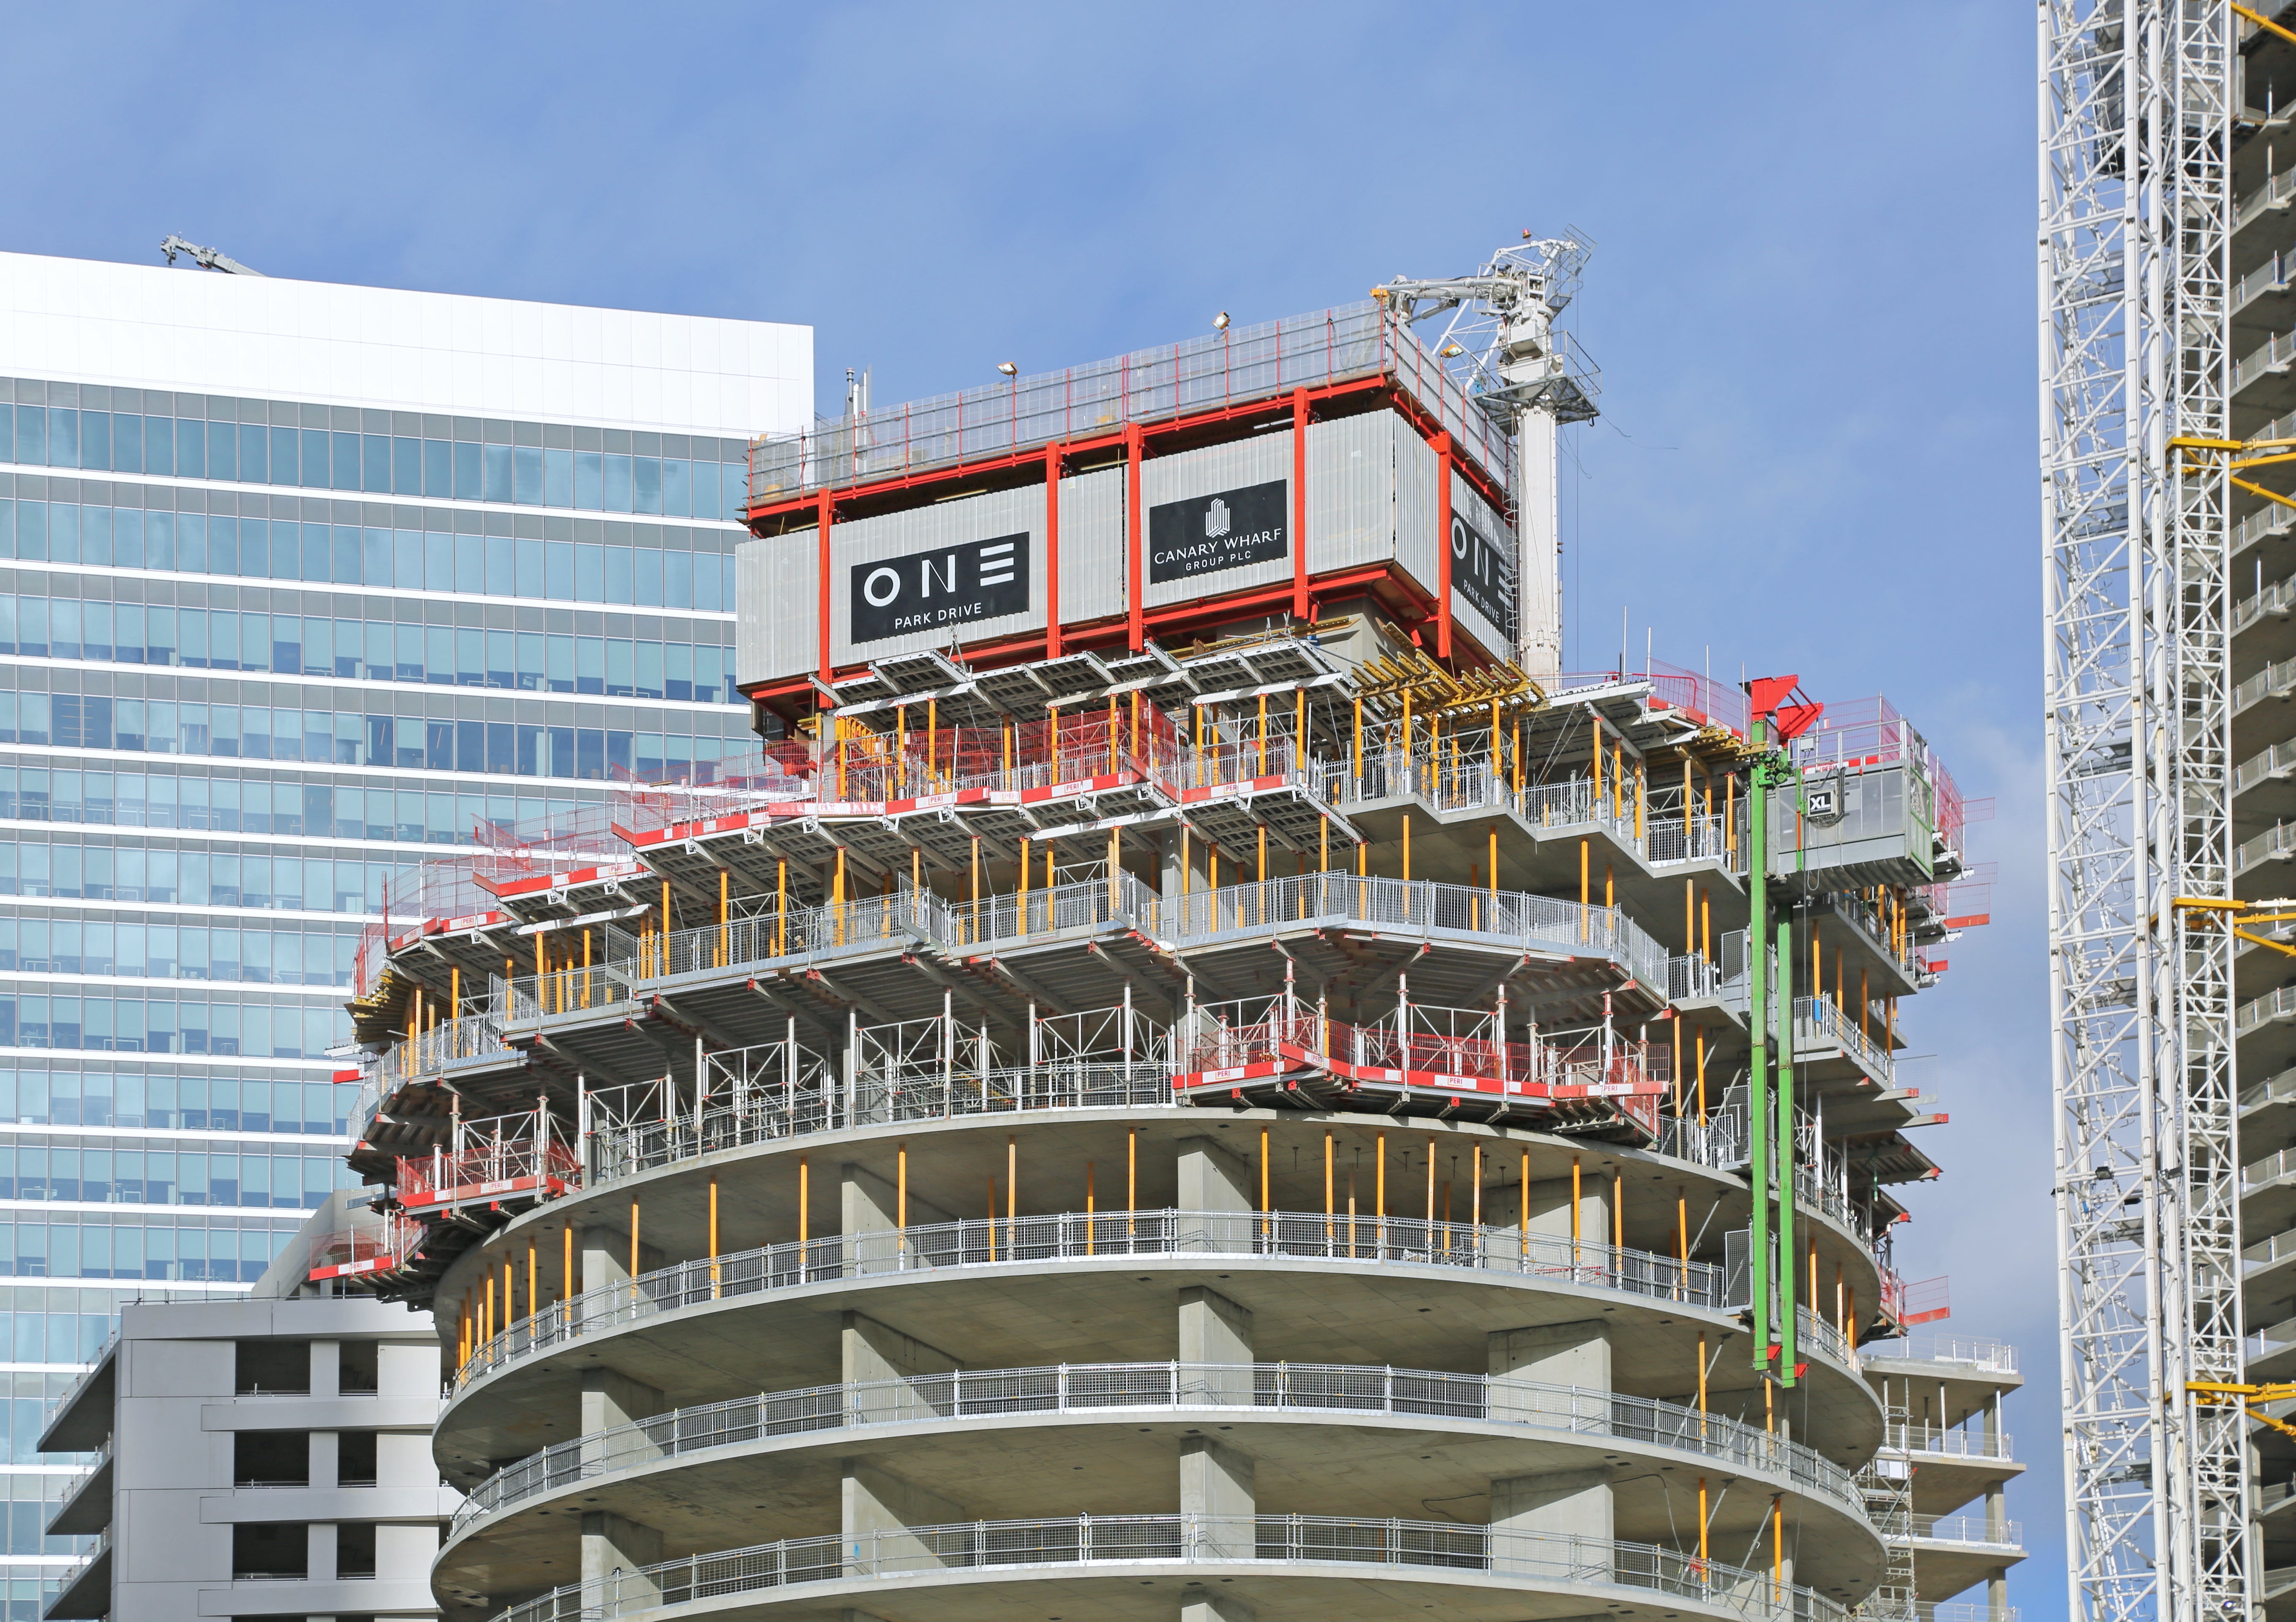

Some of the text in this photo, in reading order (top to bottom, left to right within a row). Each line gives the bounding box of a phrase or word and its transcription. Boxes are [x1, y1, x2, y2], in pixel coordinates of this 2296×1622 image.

[1154, 528, 1282, 564] CANARY WHARF
[1185, 550, 1251, 571] GROUP PLC
[1451, 517, 1512, 609] ONE
[863, 542, 1014, 607] ONE
[894, 602, 982, 629] PARK DRIVE
[1464, 579, 1499, 623] PARK DRIVE
[1810, 795, 1830, 810] XL
